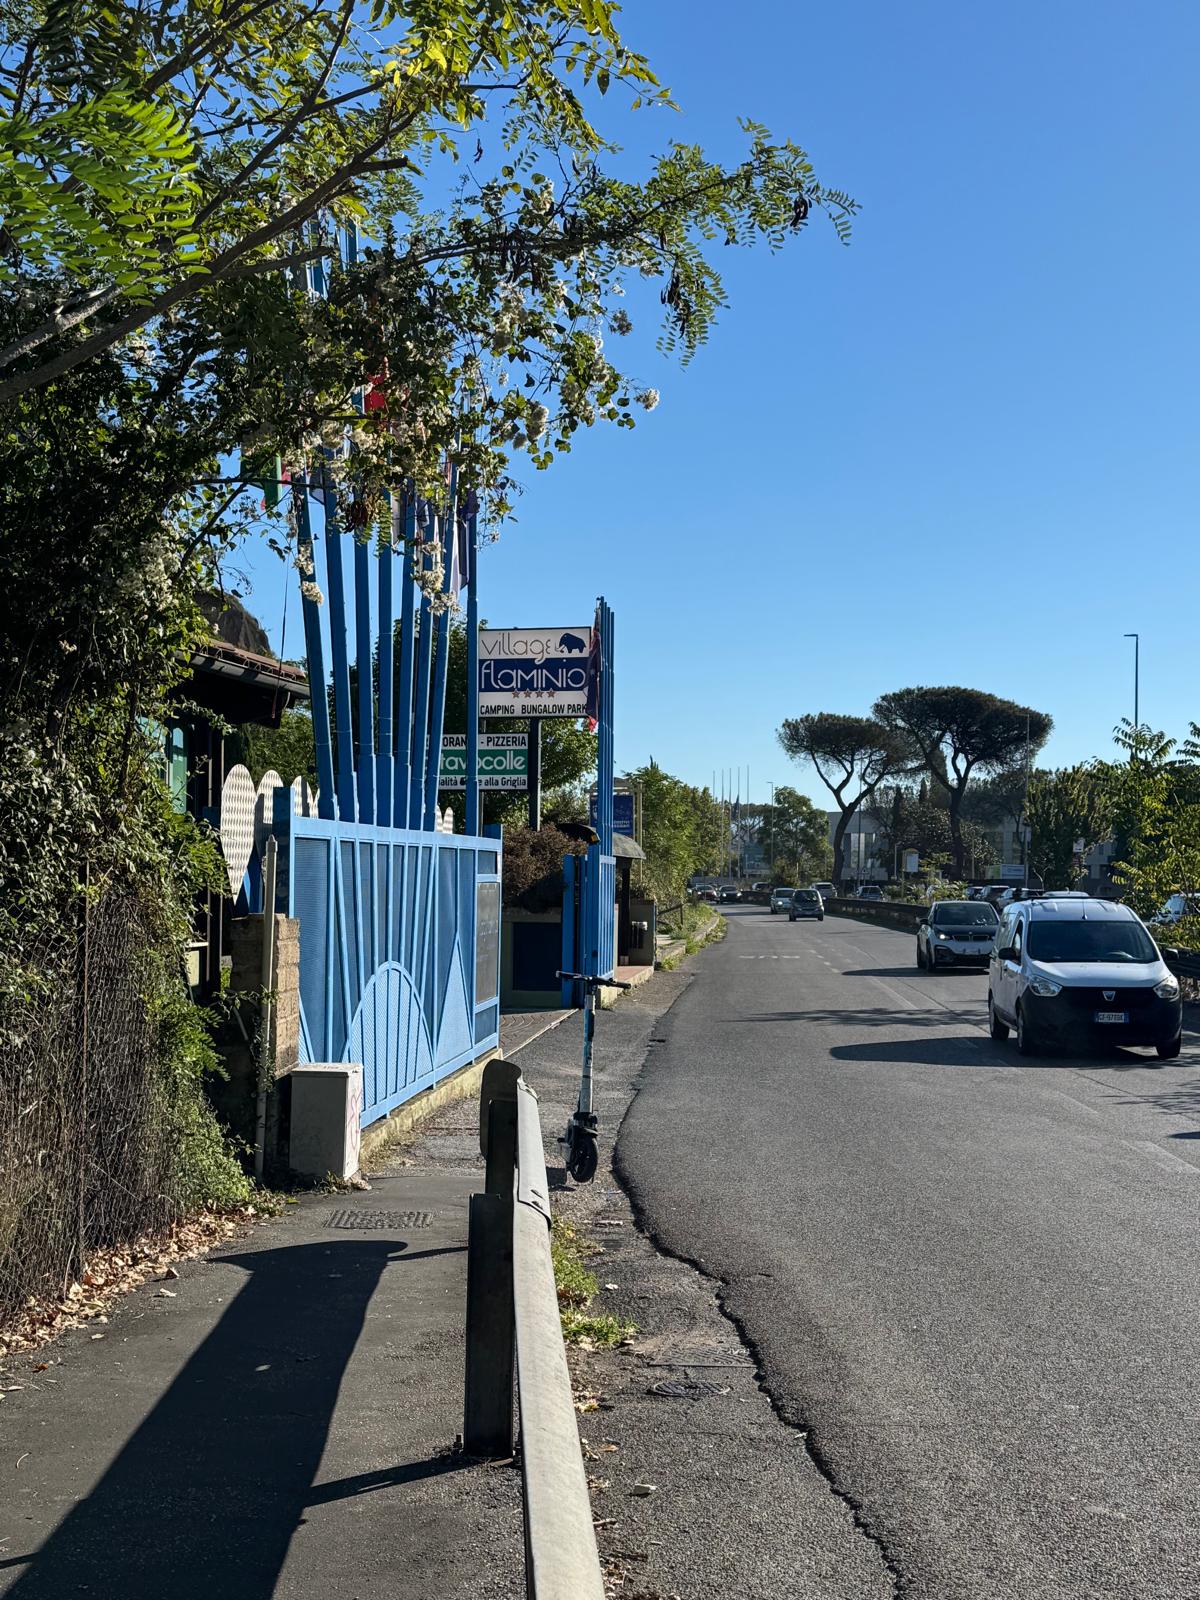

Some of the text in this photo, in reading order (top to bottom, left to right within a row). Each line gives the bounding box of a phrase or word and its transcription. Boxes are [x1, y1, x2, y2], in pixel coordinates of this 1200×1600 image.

[480, 703, 588, 715] CAMPING BUNGALOW PARK
[486, 736, 527, 747] PIZZERIA
[484, 776, 499, 786] alla
[501, 776, 527, 788] Griglia
